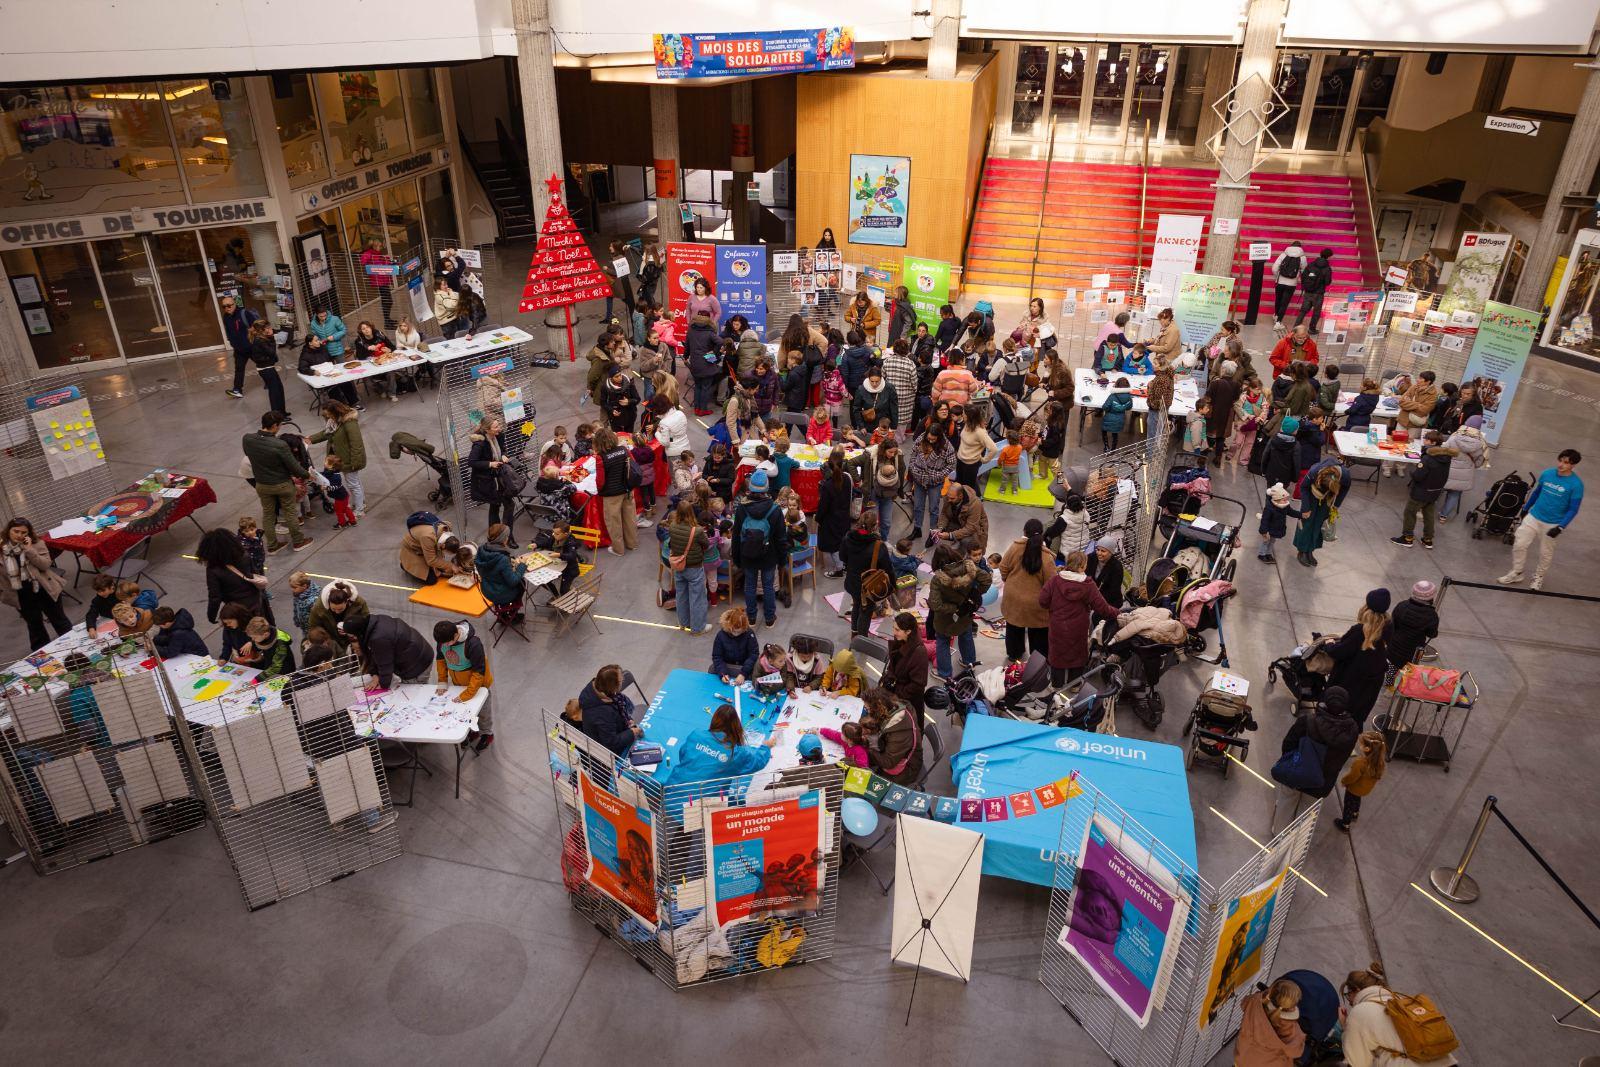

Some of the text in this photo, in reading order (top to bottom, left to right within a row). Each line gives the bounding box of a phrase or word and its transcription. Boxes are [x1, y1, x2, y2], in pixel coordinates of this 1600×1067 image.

[703, 41, 760, 54] MOIS DES
[728, 50, 802, 66] SOLIDARITÉS
[1490, 120, 1526, 130] Exposition
[321, 176, 359, 199] OFFICE
[386, 152, 433, 179] TOURISME
[1, 202, 266, 243] OFFICE DE TOURISME
[544, 235, 574, 248] Marché
[1157, 237, 1199, 246] ANNECY
[1478, 238, 1506, 246] BDfugue
[543, 248, 582, 262] de Noël
[724, 249, 750, 259] Enfance
[695, 743, 721, 758] unicef
[1082, 741, 1147, 760] unicef
[966, 752, 990, 797] unicef
[741, 809, 764, 818] chaque
[764, 805, 784, 814] enfant
[726, 813, 785, 830] un monde
[741, 823, 771, 836] juste
[1108, 859, 1163, 912] une identité
